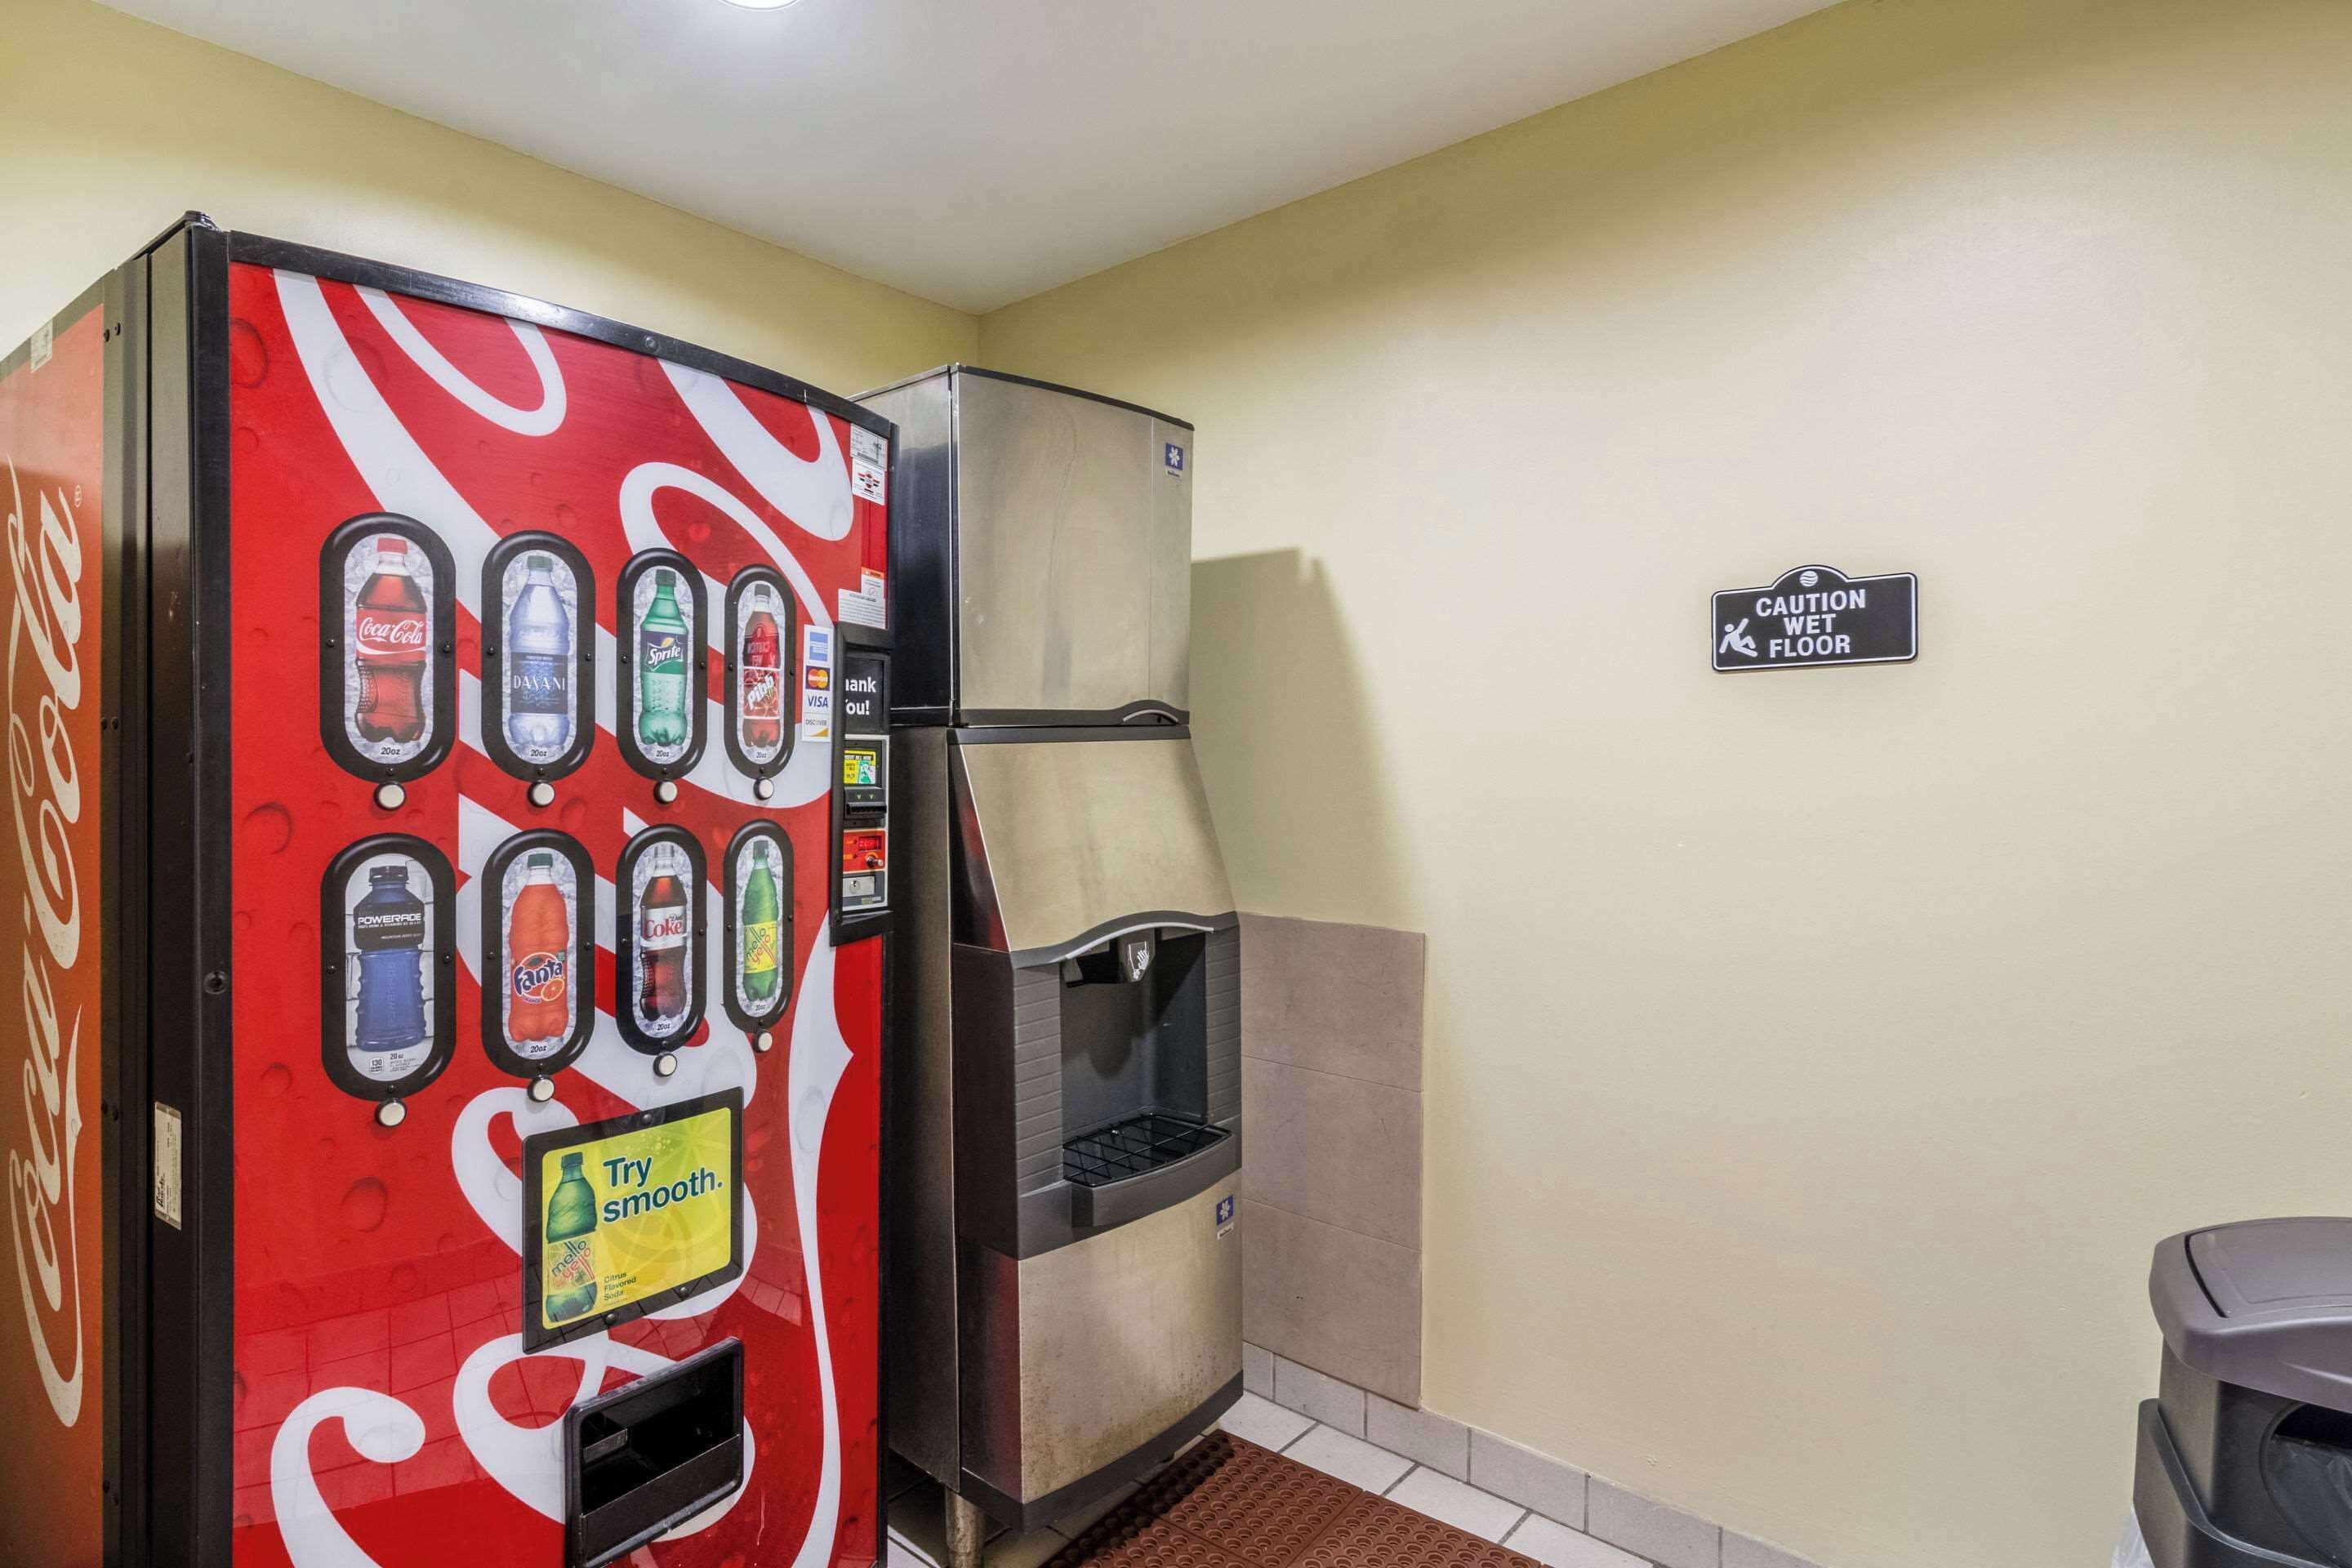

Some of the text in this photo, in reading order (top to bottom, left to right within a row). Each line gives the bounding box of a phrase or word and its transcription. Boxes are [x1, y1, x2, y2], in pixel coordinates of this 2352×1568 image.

[1756, 589, 1866, 617] CAUTION
[359, 617, 425, 644] Coca-Cola
[1784, 613, 1837, 635] WET
[648, 644, 681, 666] Sprite
[1769, 635, 1851, 658] FLOOR
[514, 675, 566, 693] DASANI
[844, 676, 876, 693] ank
[808, 695, 829, 708] VISA
[844, 698, 871, 715] ou!
[380, 746, 401, 756] 20oz
[529, 748, 547, 758] 20oz
[655, 749, 670, 759] 20oz
[358, 912, 422, 925] POWERADE
[644, 919, 684, 940] Coke
[8, 453, 83, 1428] Coca-Cola
[746, 926, 767, 961] mello
[751, 933, 776, 965] yello
[513, 959, 564, 996] Fanta
[529, 1045, 547, 1054] 20oz
[602, 1156, 653, 1187] Try
[604, 1168, 723, 1223] smooth.
[552, 1240, 586, 1277] mello
[562, 1247, 595, 1281] yello
[604, 1272, 627, 1284] Citrus
[604, 1276, 637, 1292] Flavored
[604, 1290, 624, 1301] Soda
